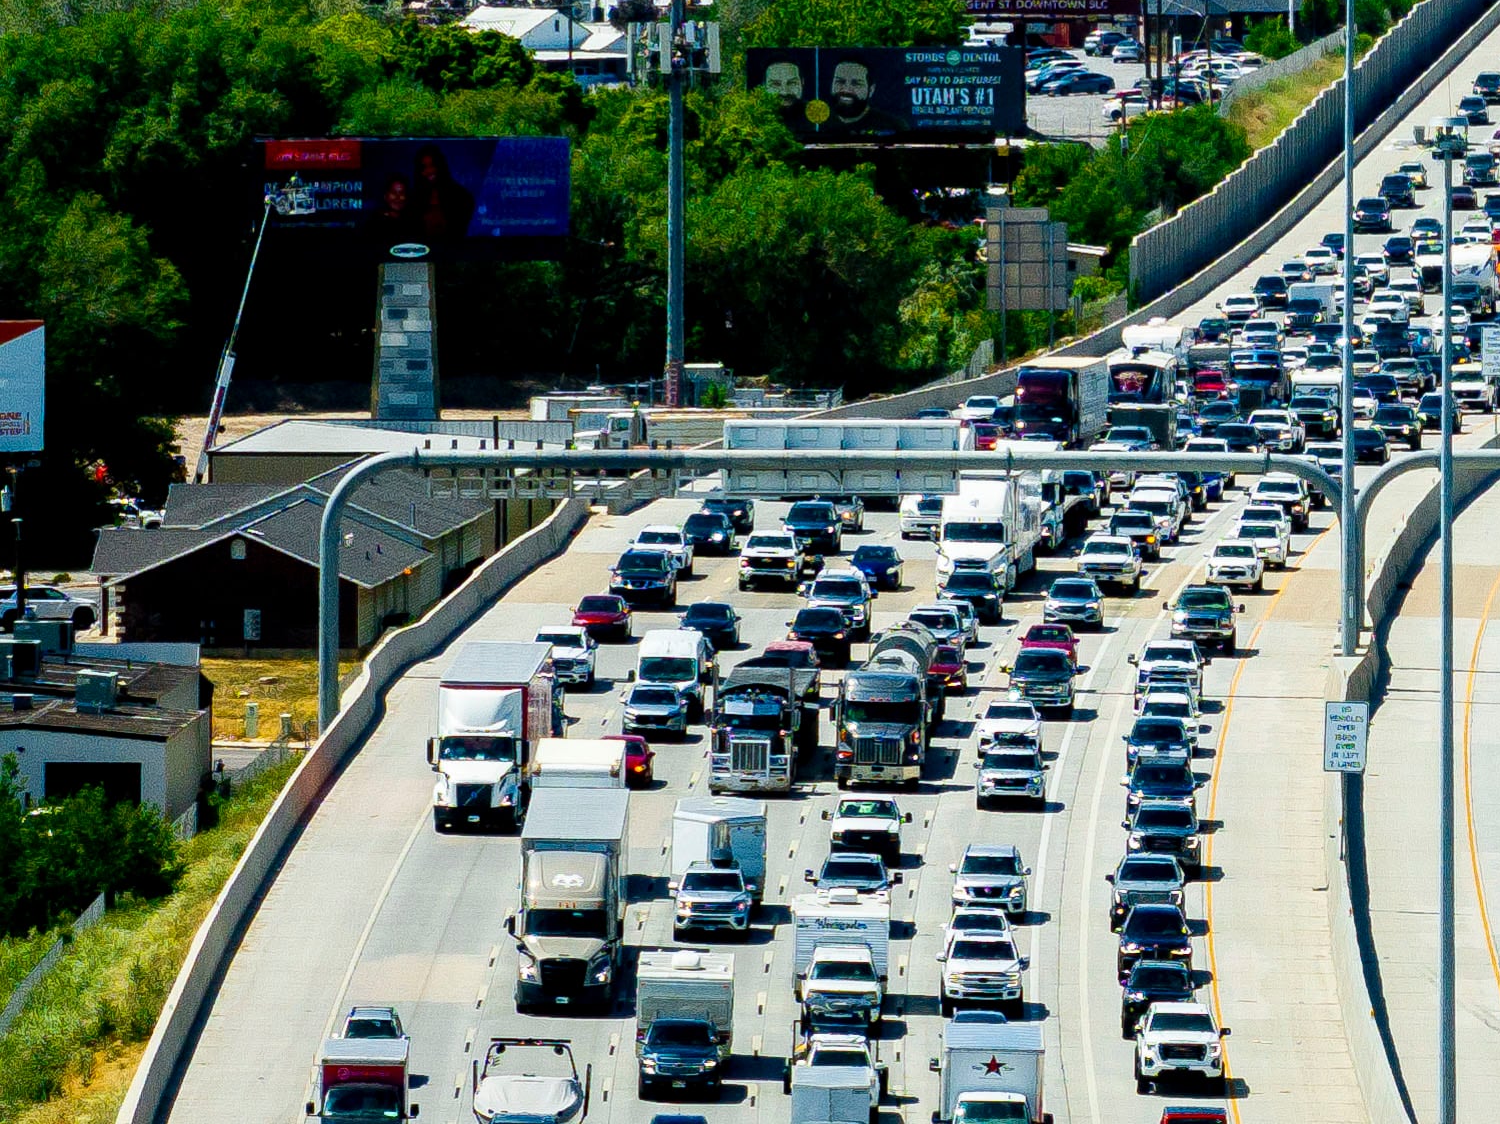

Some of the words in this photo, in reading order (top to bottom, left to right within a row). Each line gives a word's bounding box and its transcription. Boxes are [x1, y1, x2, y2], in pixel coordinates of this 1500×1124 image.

[1015, 0, 1086, 10] DOWNTOWN
[1088, 0, 1109, 10] SLC
[962, 52, 1002, 63] DENTAL
[911, 87, 970, 106] UTAH'S
[975, 87, 995, 106] #1
